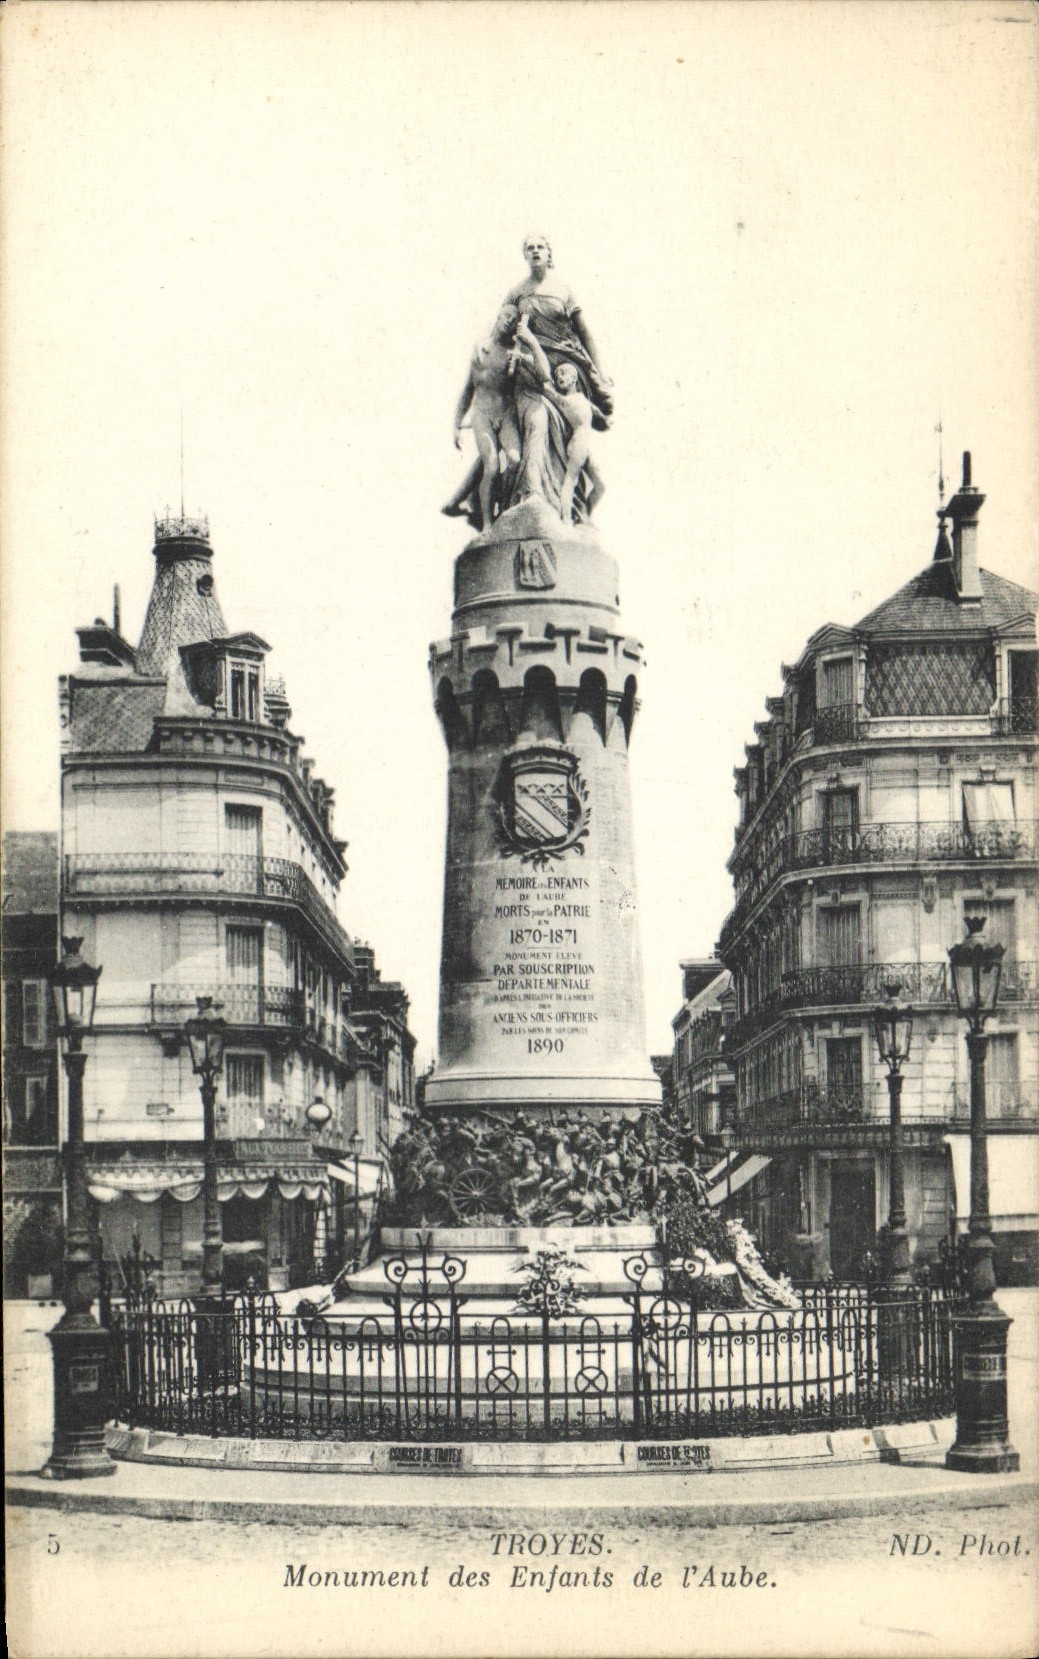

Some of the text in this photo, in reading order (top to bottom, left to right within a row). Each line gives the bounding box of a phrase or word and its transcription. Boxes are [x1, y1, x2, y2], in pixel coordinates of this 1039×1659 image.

[547, 877, 589, 890] ENFANTS
[519, 893, 529, 901] DE
[494, 905, 530, 918] MORTS
[554, 904, 591, 917] PATRIE
[510, 929, 577, 944] 1870-1871
[504, 952, 551, 960] MONUMENT
[493, 963, 595, 976] PAR SOUSCRIPTION
[493, 1012, 528, 1023] ANCIENS
[527, 1039, 564, 1054] 1890
[638, 1446, 671, 1461] COURSES
[672, 1446, 681, 1460] DE
